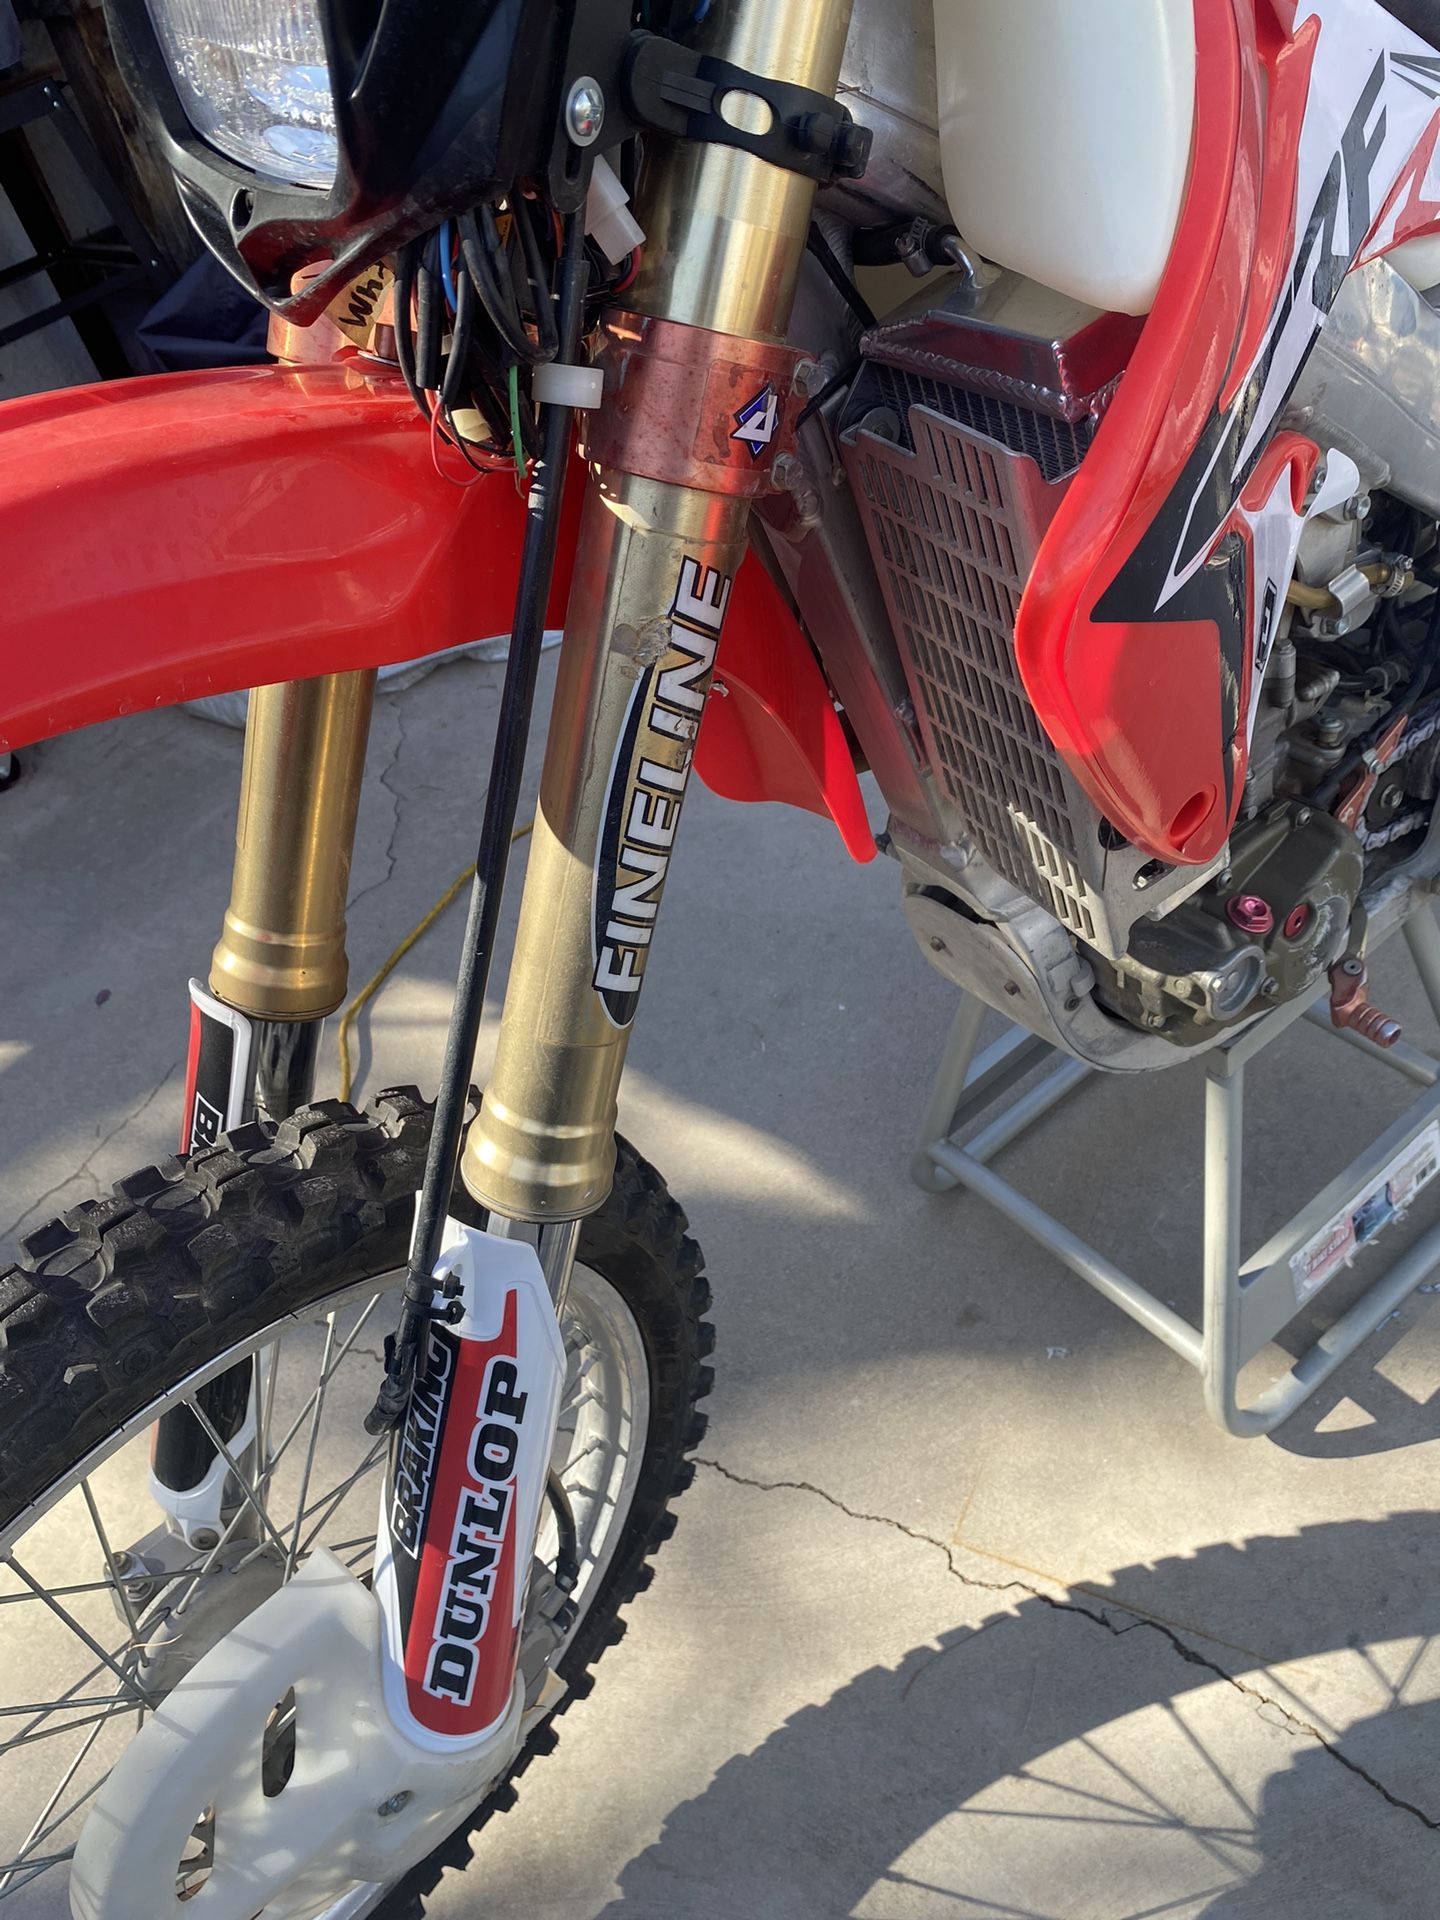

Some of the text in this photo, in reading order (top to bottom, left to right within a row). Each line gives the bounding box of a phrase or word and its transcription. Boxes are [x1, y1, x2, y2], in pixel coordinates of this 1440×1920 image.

[593, 555, 731, 992] FINELINE
[390, 1332, 451, 1560] BRAKING
[425, 1356, 529, 1705] DUNLOP
